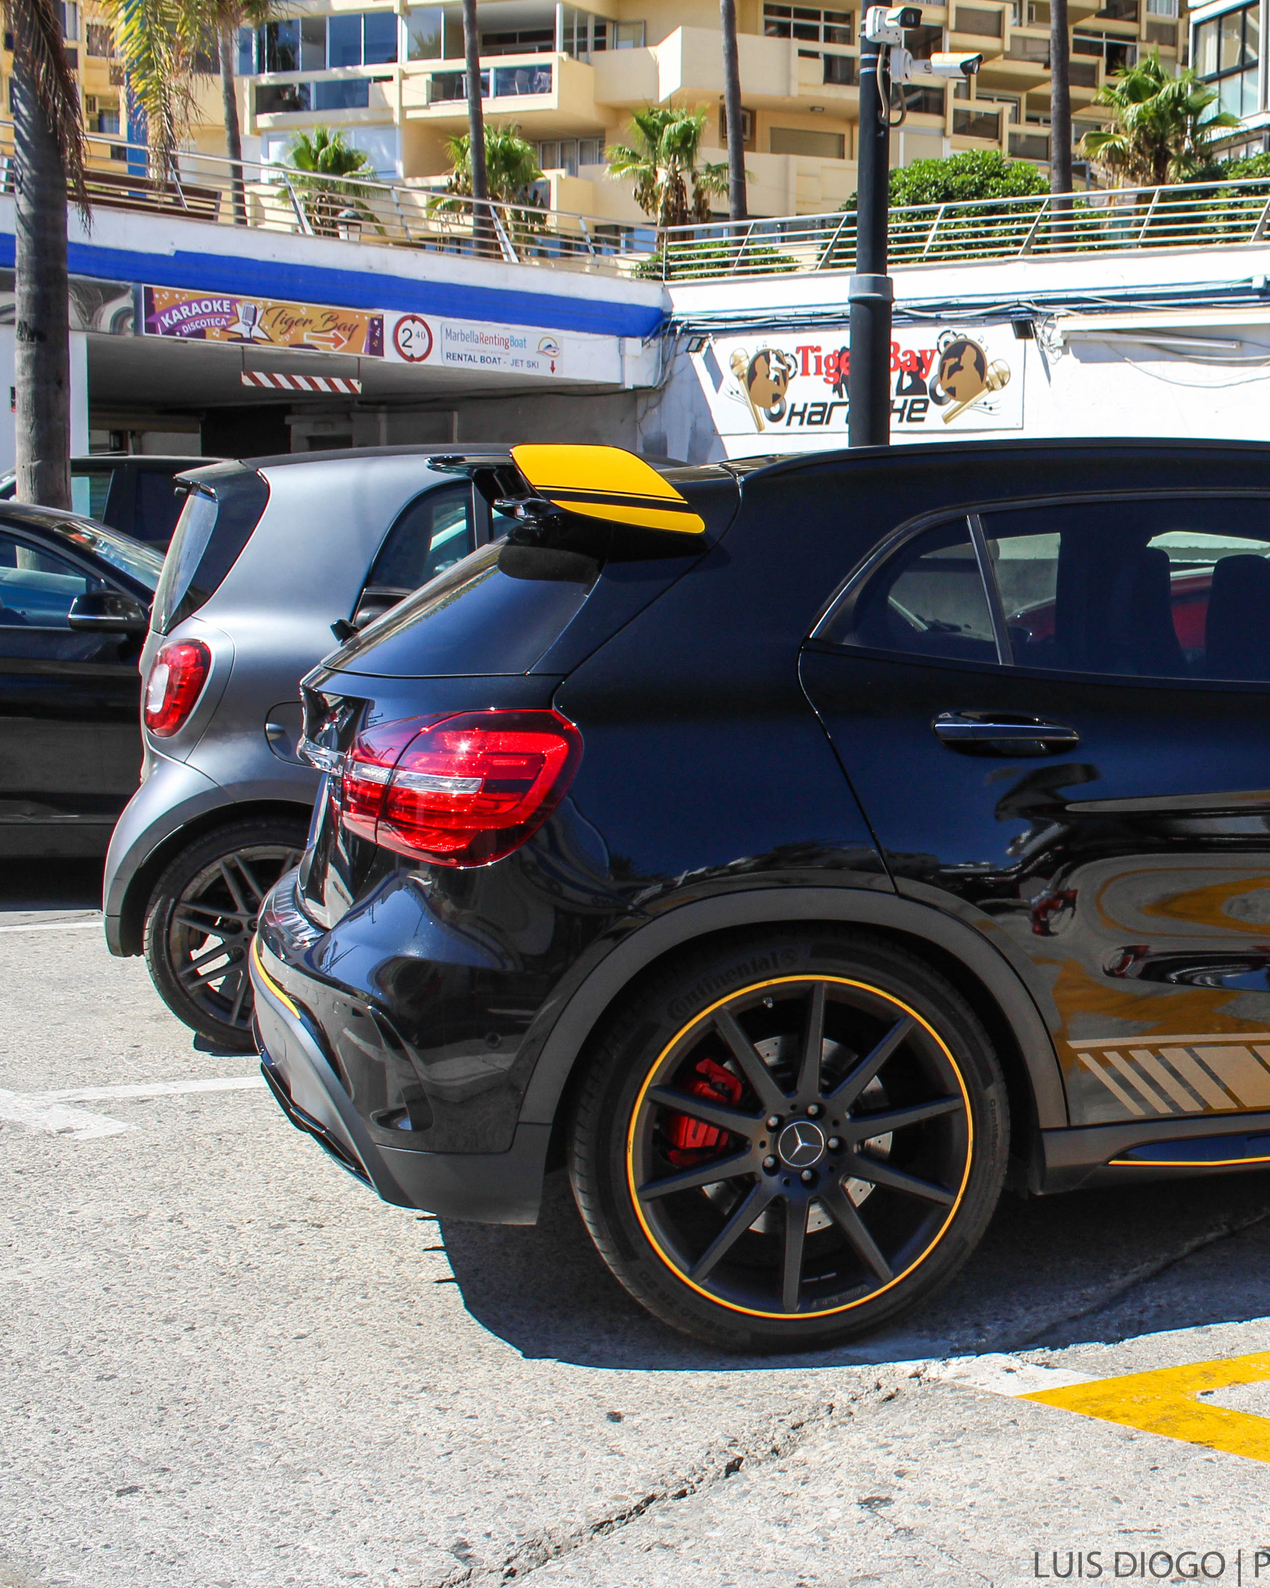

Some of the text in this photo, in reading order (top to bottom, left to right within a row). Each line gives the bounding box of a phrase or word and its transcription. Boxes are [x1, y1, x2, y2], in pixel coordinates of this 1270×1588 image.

[160, 300, 231, 328] KARAOKE
[265, 306, 359, 341] Tiger Bay
[181, 318, 227, 334] DISCOTECA
[446, 352, 478, 363] RENTAL
[480, 355, 501, 365] BOAT
[510, 359, 524, 369] JET
[526, 360, 540, 370] SKI
